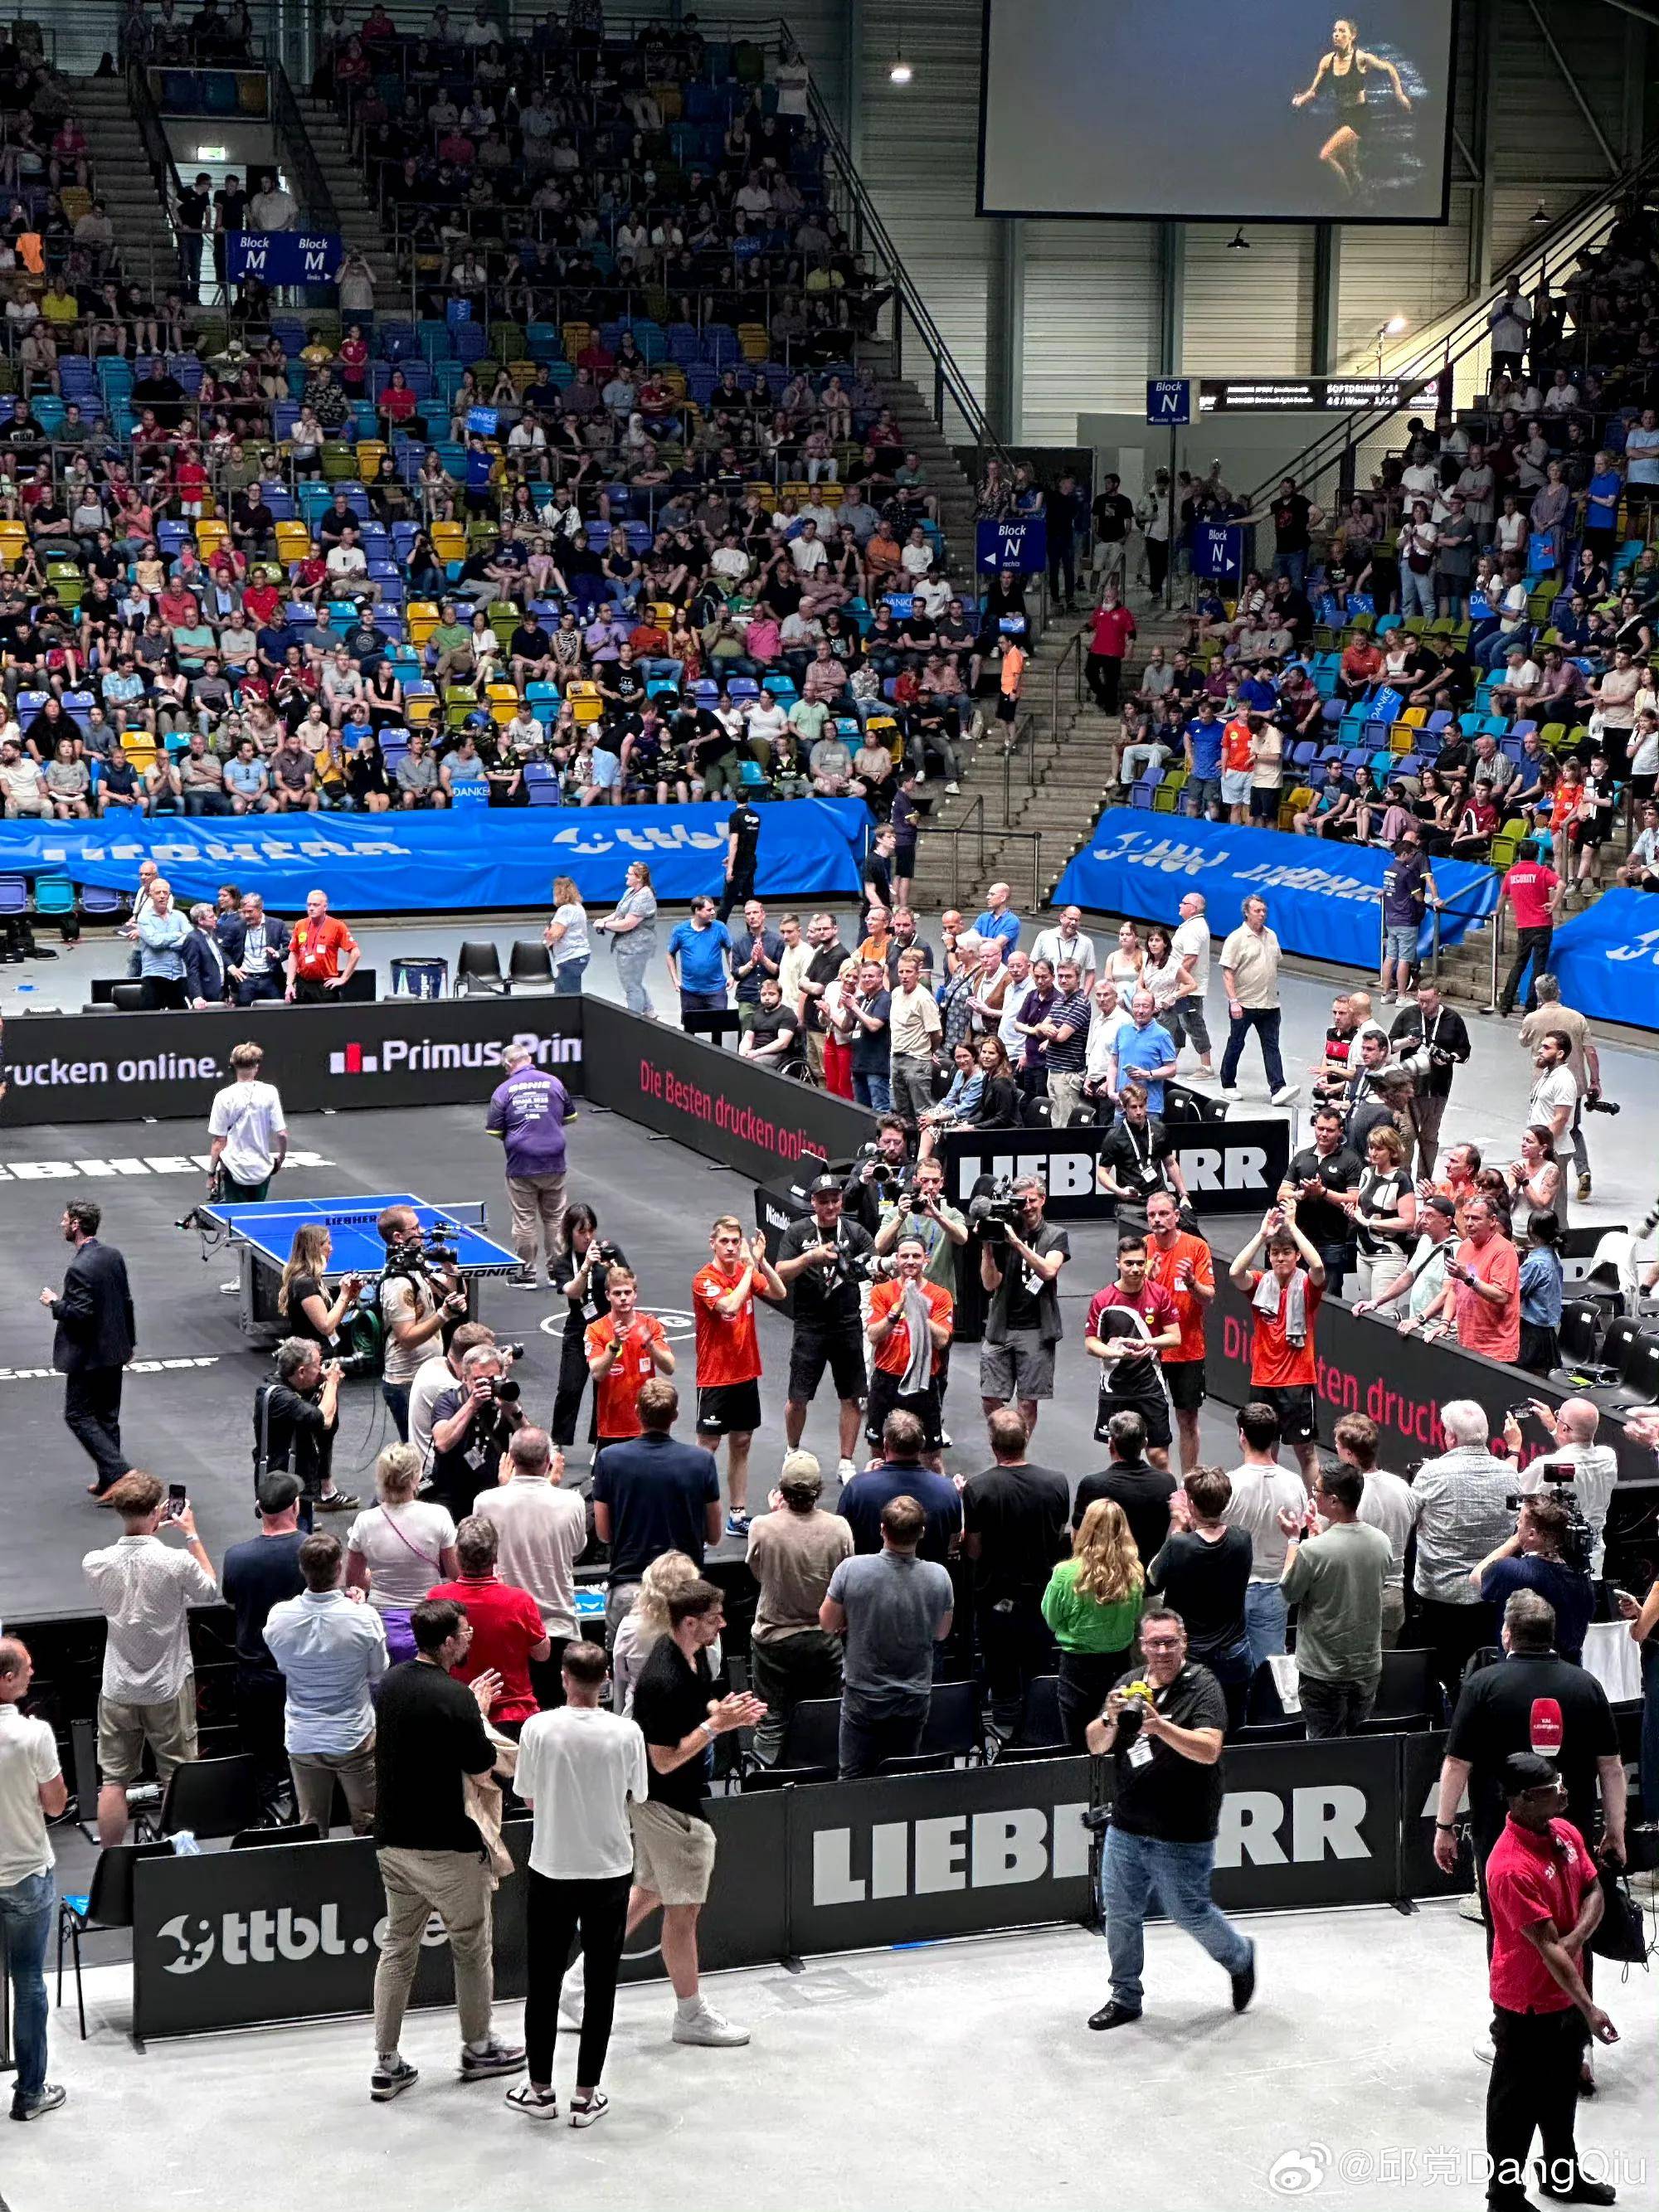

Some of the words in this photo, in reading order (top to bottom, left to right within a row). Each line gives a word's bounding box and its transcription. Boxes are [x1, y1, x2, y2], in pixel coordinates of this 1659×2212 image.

[240, 237, 270, 248] Block
[299, 238, 328, 249] Block
[246, 250, 265, 269] M
[304, 251, 325, 270] M
[1155, 382, 1182, 391] Block
[1161, 394, 1178, 412] N
[999, 525, 1026, 536] Block
[1209, 529, 1227, 541] Block
[1005, 538, 1021, 557] N
[1212, 543, 1224, 562] N
[453, 787, 488, 796] DANKE
[1510, 873, 1537, 884] SECURITY
[117, 1053, 224, 1082] online.
[640, 1058, 662, 1099] Die
[665, 1070, 711, 1122] Besten
[715, 1093, 775, 1151] drucken
[0, 1151, 336, 1180] BHER
[959, 1146, 1268, 1199] LIEBRR
[325, 1215, 377, 1226] LIEBHER
[1317, 1355, 1358, 1410] ten
[813, 1785, 1372, 1907] LIEBRR
